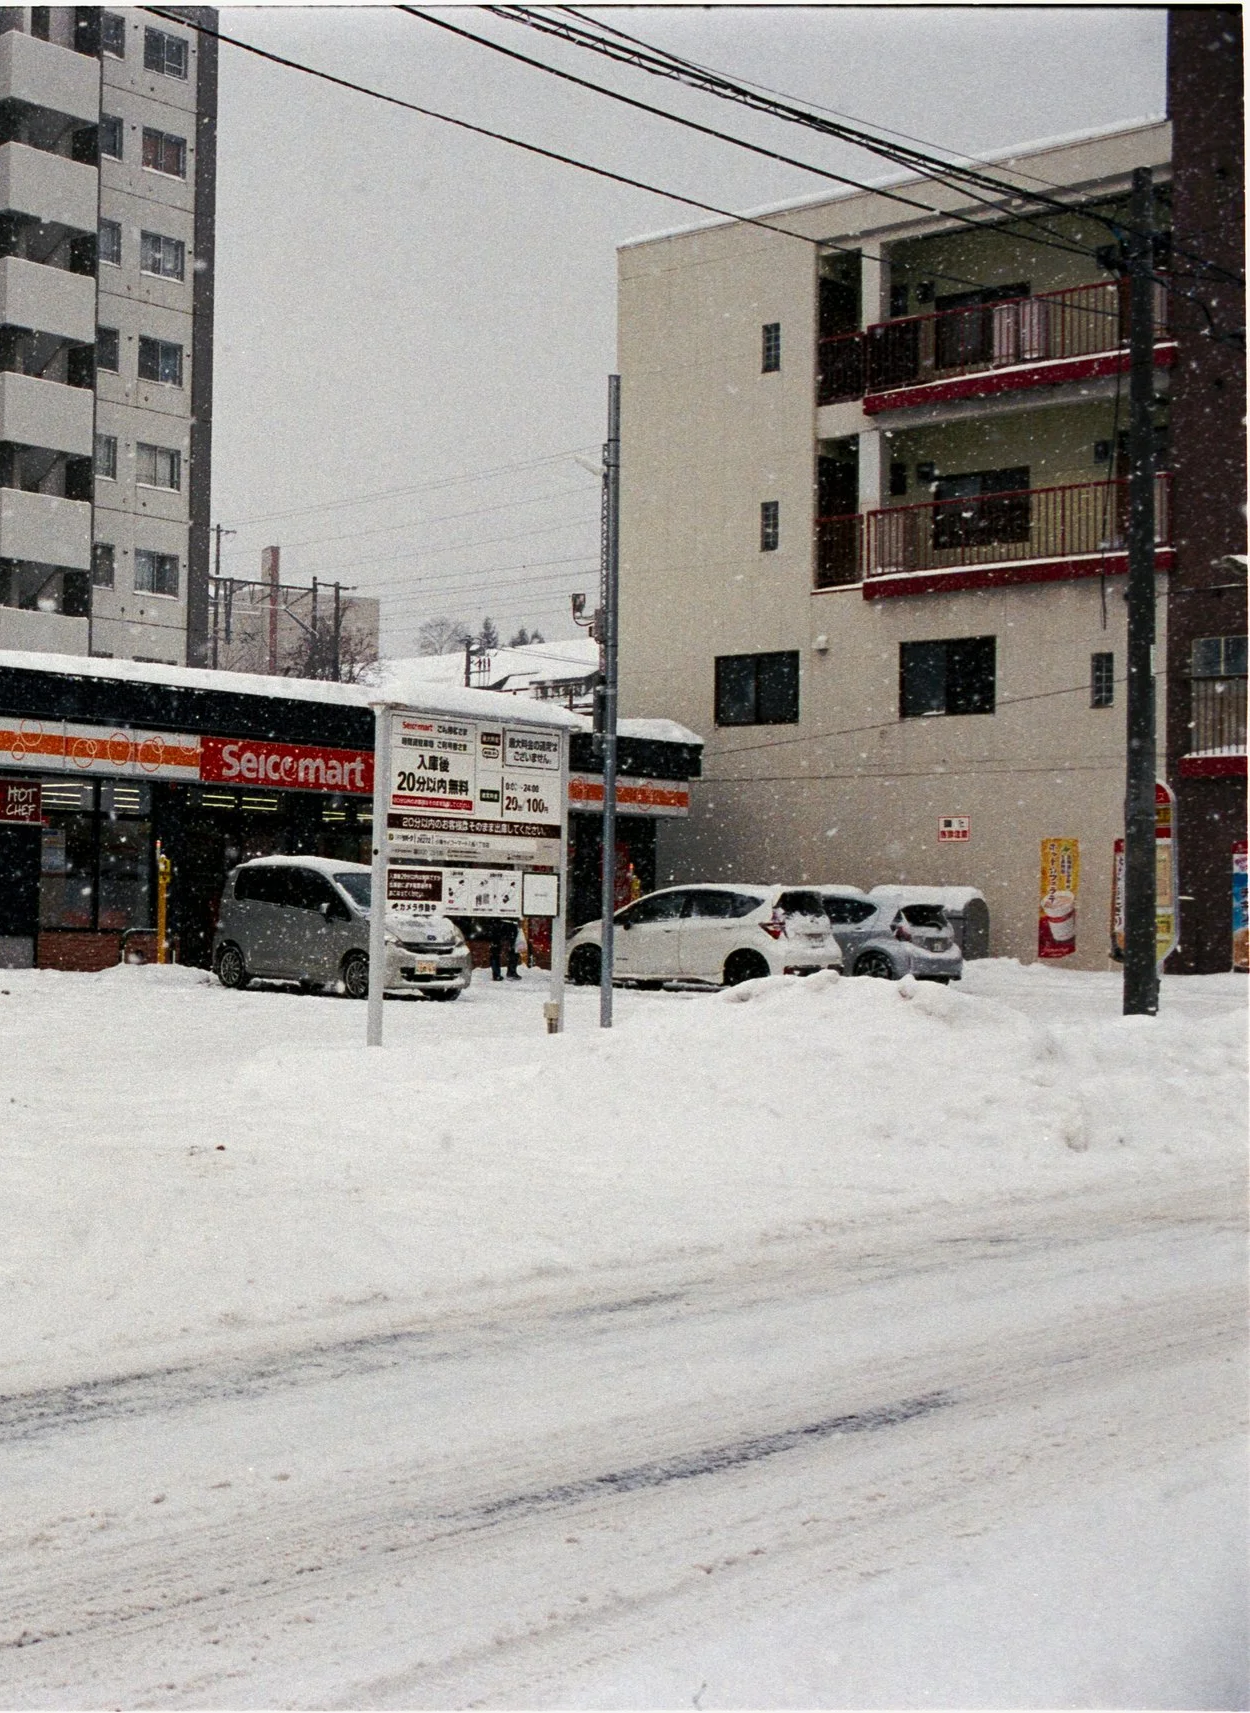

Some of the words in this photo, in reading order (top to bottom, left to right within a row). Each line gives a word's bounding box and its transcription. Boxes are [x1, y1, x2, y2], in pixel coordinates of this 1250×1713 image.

[222, 744, 364, 787] Seicomart
[417, 754, 449, 772] 入庫後
[397, 771, 469, 796] 20分以内無料
[8, 785, 38, 803] HOT
[6, 803, 37, 816] CHEF
